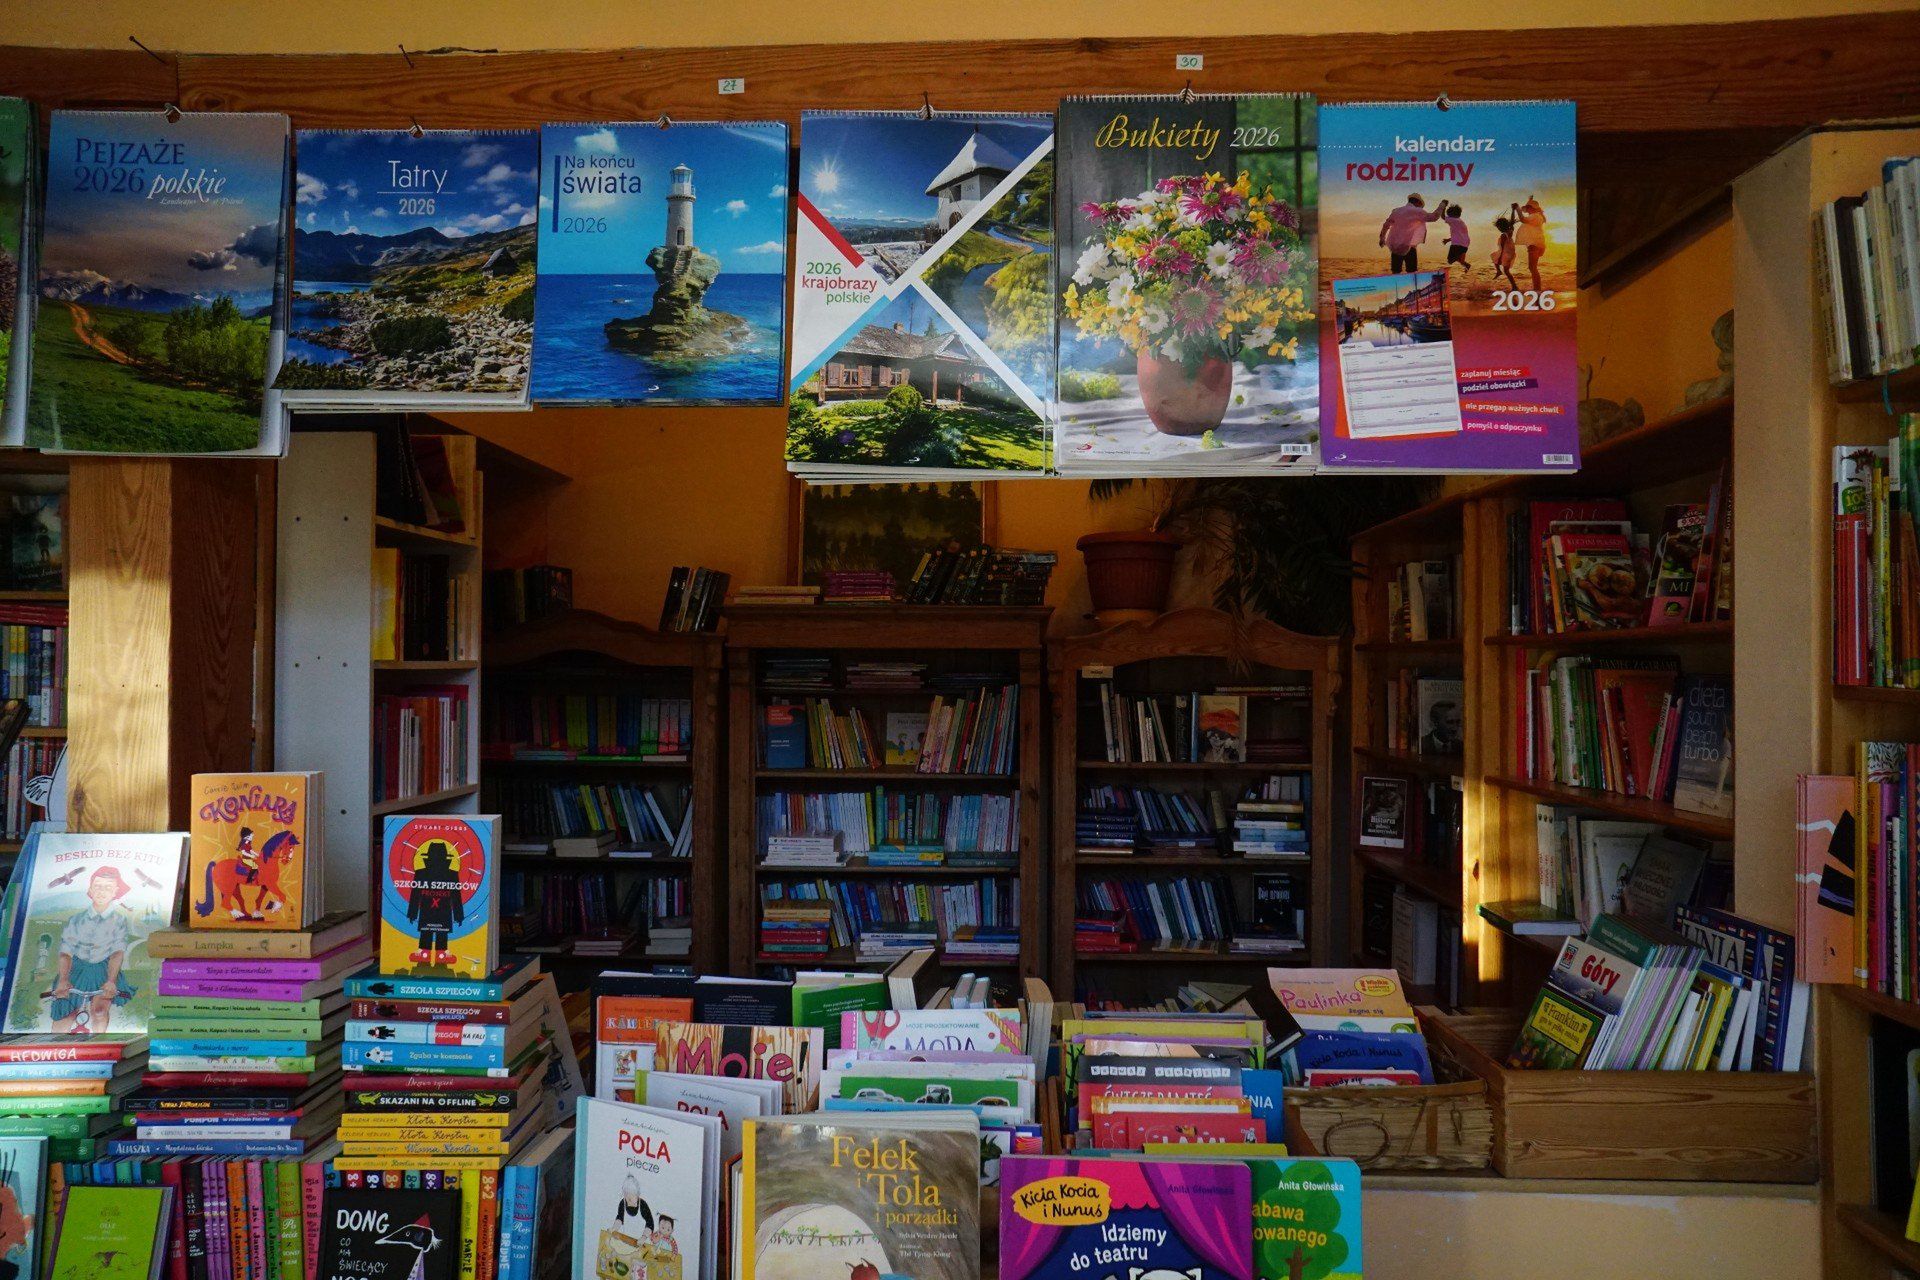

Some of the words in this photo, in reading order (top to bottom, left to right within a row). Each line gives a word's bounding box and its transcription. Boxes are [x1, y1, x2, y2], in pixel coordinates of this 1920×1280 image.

[1181, 56, 1197, 67] 30
[723, 80, 737, 92] 27
[1095, 113, 1221, 161] Bukiety
[1230, 127, 1281, 147] 2026
[1395, 136, 1495, 152] kalendarz
[74, 138, 185, 168] PEJZAŻE
[565, 155, 585, 169] Na
[590, 154, 635, 169] końcu
[388, 160, 448, 193] Tatry
[1346, 157, 1474, 187] rodzinny
[73, 166, 145, 193] 2026
[147, 169, 227, 203] polskie
[562, 171, 642, 195] świata
[399, 199, 436, 216] 2026
[563, 217, 607, 234] 2026
[806, 262, 842, 275] 2026
[801, 275, 878, 293] krajobrazy
[826, 292, 871, 305] polskie
[1491, 290, 1556, 311] 2026
[1460, 370, 1492, 379] zaplanuj
[1493, 368, 1521, 377] miesiąc
[1462, 383, 1490, 393] podziel
[199, 785, 298, 825] KONIARA
[54, 849, 104, 864] BESKID
[106, 849, 133, 860] BEZ
[134, 853, 165, 865] KITU
[394, 879, 429, 889] SZKOŁA
[431, 879, 479, 891] SZPIEGÓW
[194, 940, 234, 952] Lampka
[1580, 953, 1621, 996] Góry
[400, 986, 433, 995] SZKOŁA
[435, 985, 481, 996] SZPIEGÓW
[1279, 989, 1363, 1010] Paulinka
[417, 1006, 443, 1014] SZKOŁA
[444, 1007, 481, 1016] SZPIEGÓW
[905, 1022, 923, 1030] MOJE
[925, 1022, 980, 1030] PROJEKTOWANIE
[462, 1031, 471, 1039] NA
[471, 1032, 486, 1040] FALI
[905, 1035, 976, 1050] MODA
[380, 1097, 420, 1105] SKAZANI
[421, 1097, 434, 1105] NA
[438, 1097, 477, 1107] OFFLINE
[439, 1114, 479, 1125] Kerstin
[432, 1129, 470, 1140] Kerstin
[618, 1129, 672, 1163] POLA
[830, 1135, 920, 1171] Felek
[626, 1156, 660, 1174] piecze
[857, 1172, 862, 1188] i
[866, 1173, 941, 1207] Tola
[1167, 1184, 1190, 1194] Anita
[1191, 1184, 1235, 1195] Głowińska
[1278, 1179, 1301, 1191] Anita
[1302, 1179, 1345, 1192] Głowińska
[1020, 1188, 1056, 1209] Kicia
[1060, 1183, 1101, 1199] Kocia
[1043, 1203, 1048, 1218] i
[1051, 1201, 1104, 1218] Nunuś
[1252, 1200, 1305, 1222] abawa
[337, 1209, 390, 1234] DONG
[876, 1208, 880, 1223] i
[885, 1208, 959, 1230] porządki
[340, 1237, 351, 1247] CO
[1101, 1224, 1168, 1247] Idziemy
[1252, 1226, 1328, 1248] owanego
[339, 1249, 351, 1257] MA
[462, 1238, 473, 1274] SVARTLE
[499, 1232, 511, 1270] BRUNE
[1070, 1253, 1090, 1272] do
[1094, 1246, 1149, 1266] teatru
